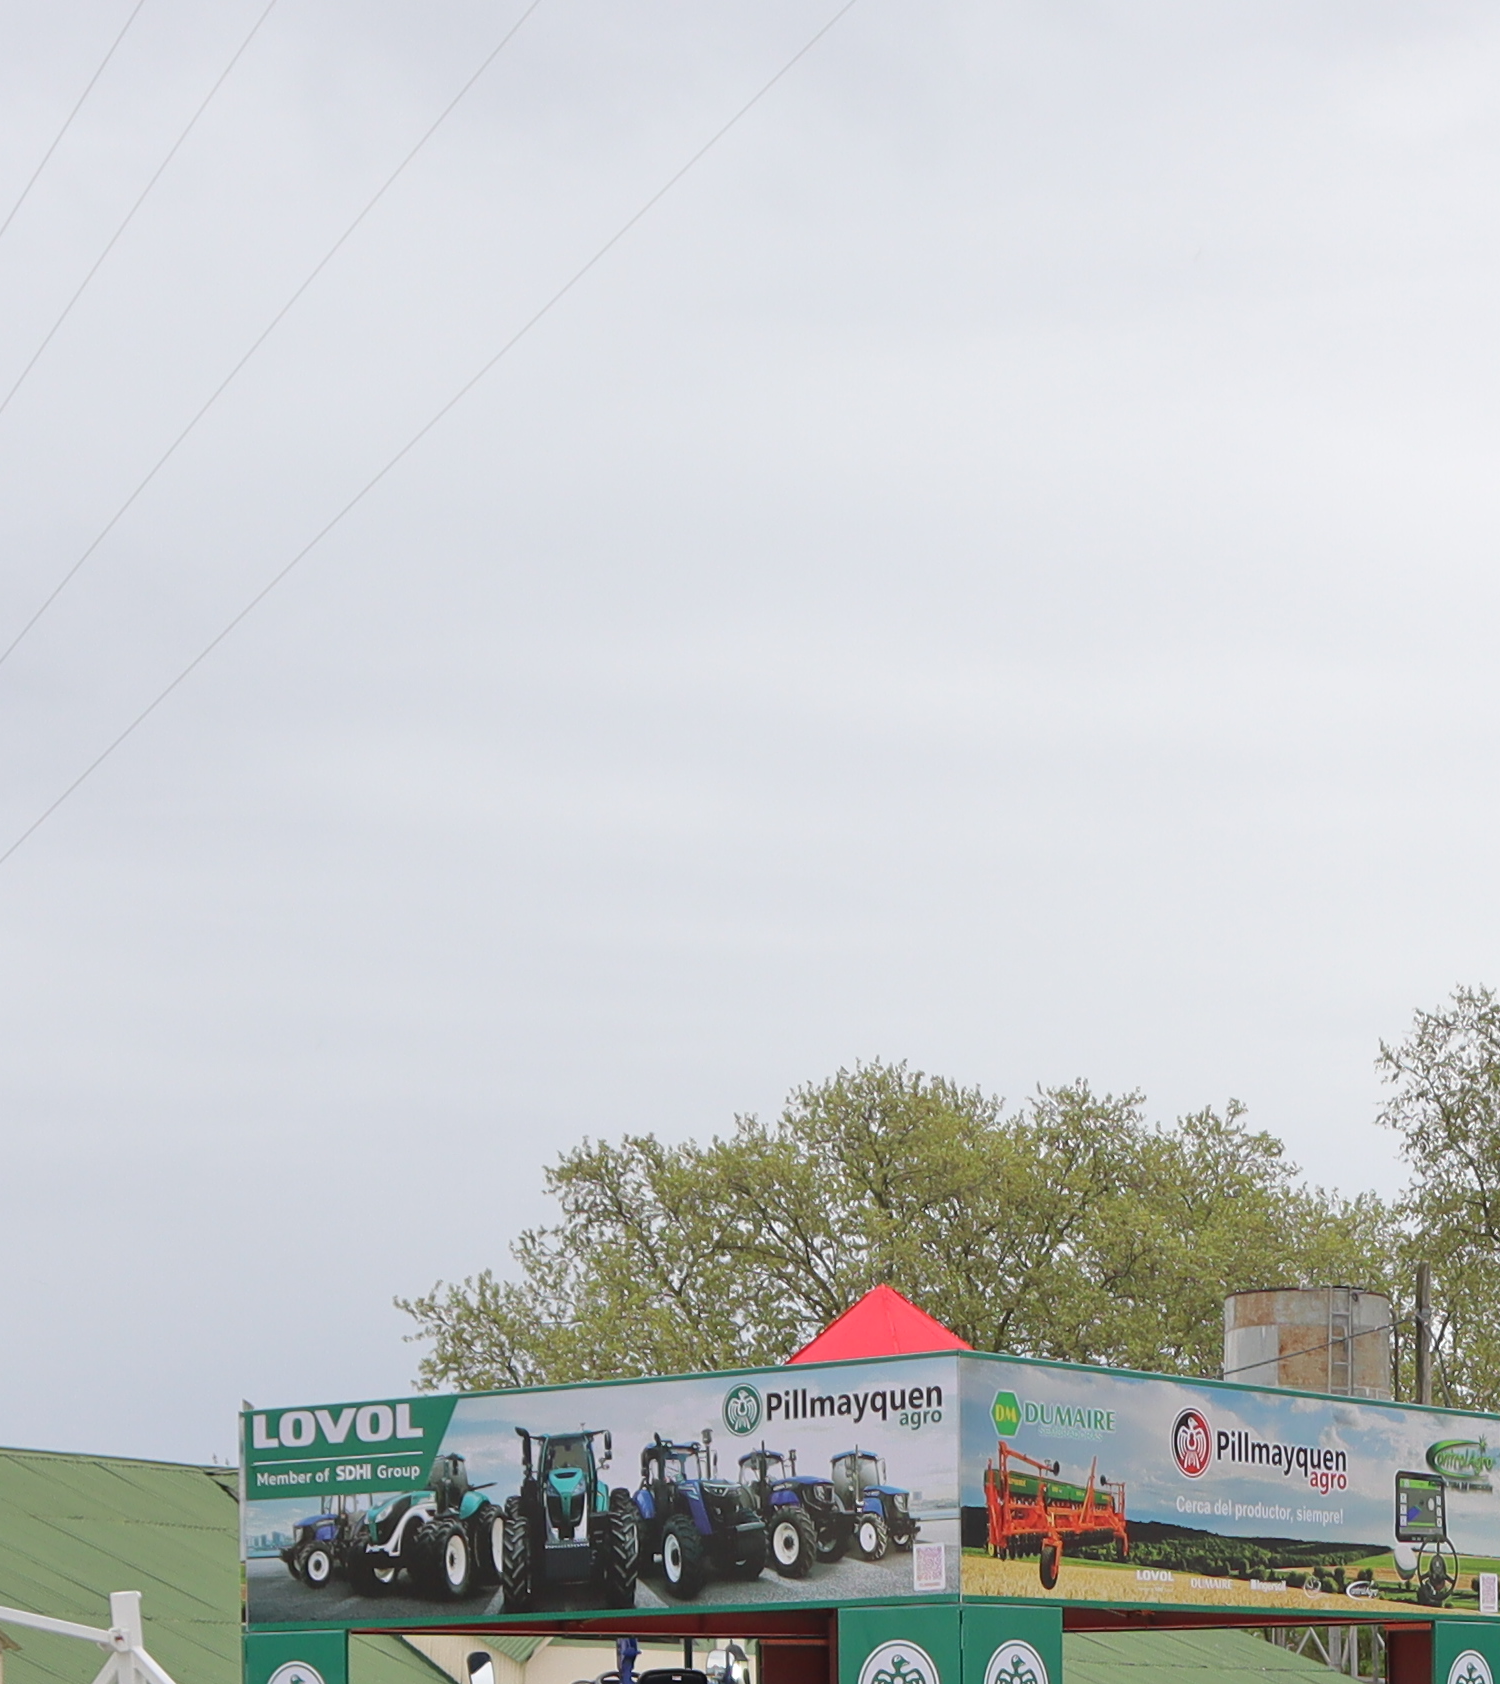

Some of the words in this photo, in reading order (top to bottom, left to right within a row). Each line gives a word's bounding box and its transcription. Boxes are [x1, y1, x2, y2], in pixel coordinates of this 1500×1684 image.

[766, 1385, 942, 1424] Pillmayquen
[995, 1403, 1017, 1423] DM
[253, 1403, 423, 1449] LOVOL
[899, 1408, 942, 1430] agro
[1025, 1402, 1116, 1432] DUMAIRE
[1217, 1430, 1347, 1478] Pillmayquen
[256, 1471, 312, 1487] Member
[315, 1467, 330, 1483] of
[335, 1463, 372, 1481] SDHI
[377, 1464, 421, 1481] Group
[1310, 1471, 1347, 1495] agro
[1176, 1496, 1212, 1514] Cerca
[1214, 1500, 1232, 1516] del
[1235, 1502, 1294, 1523] productor,
[1296, 1506, 1344, 1526] siempre!
[1136, 1569, 1175, 1582] LOVOL
[1190, 1577, 1234, 1590] DUMAIRE
